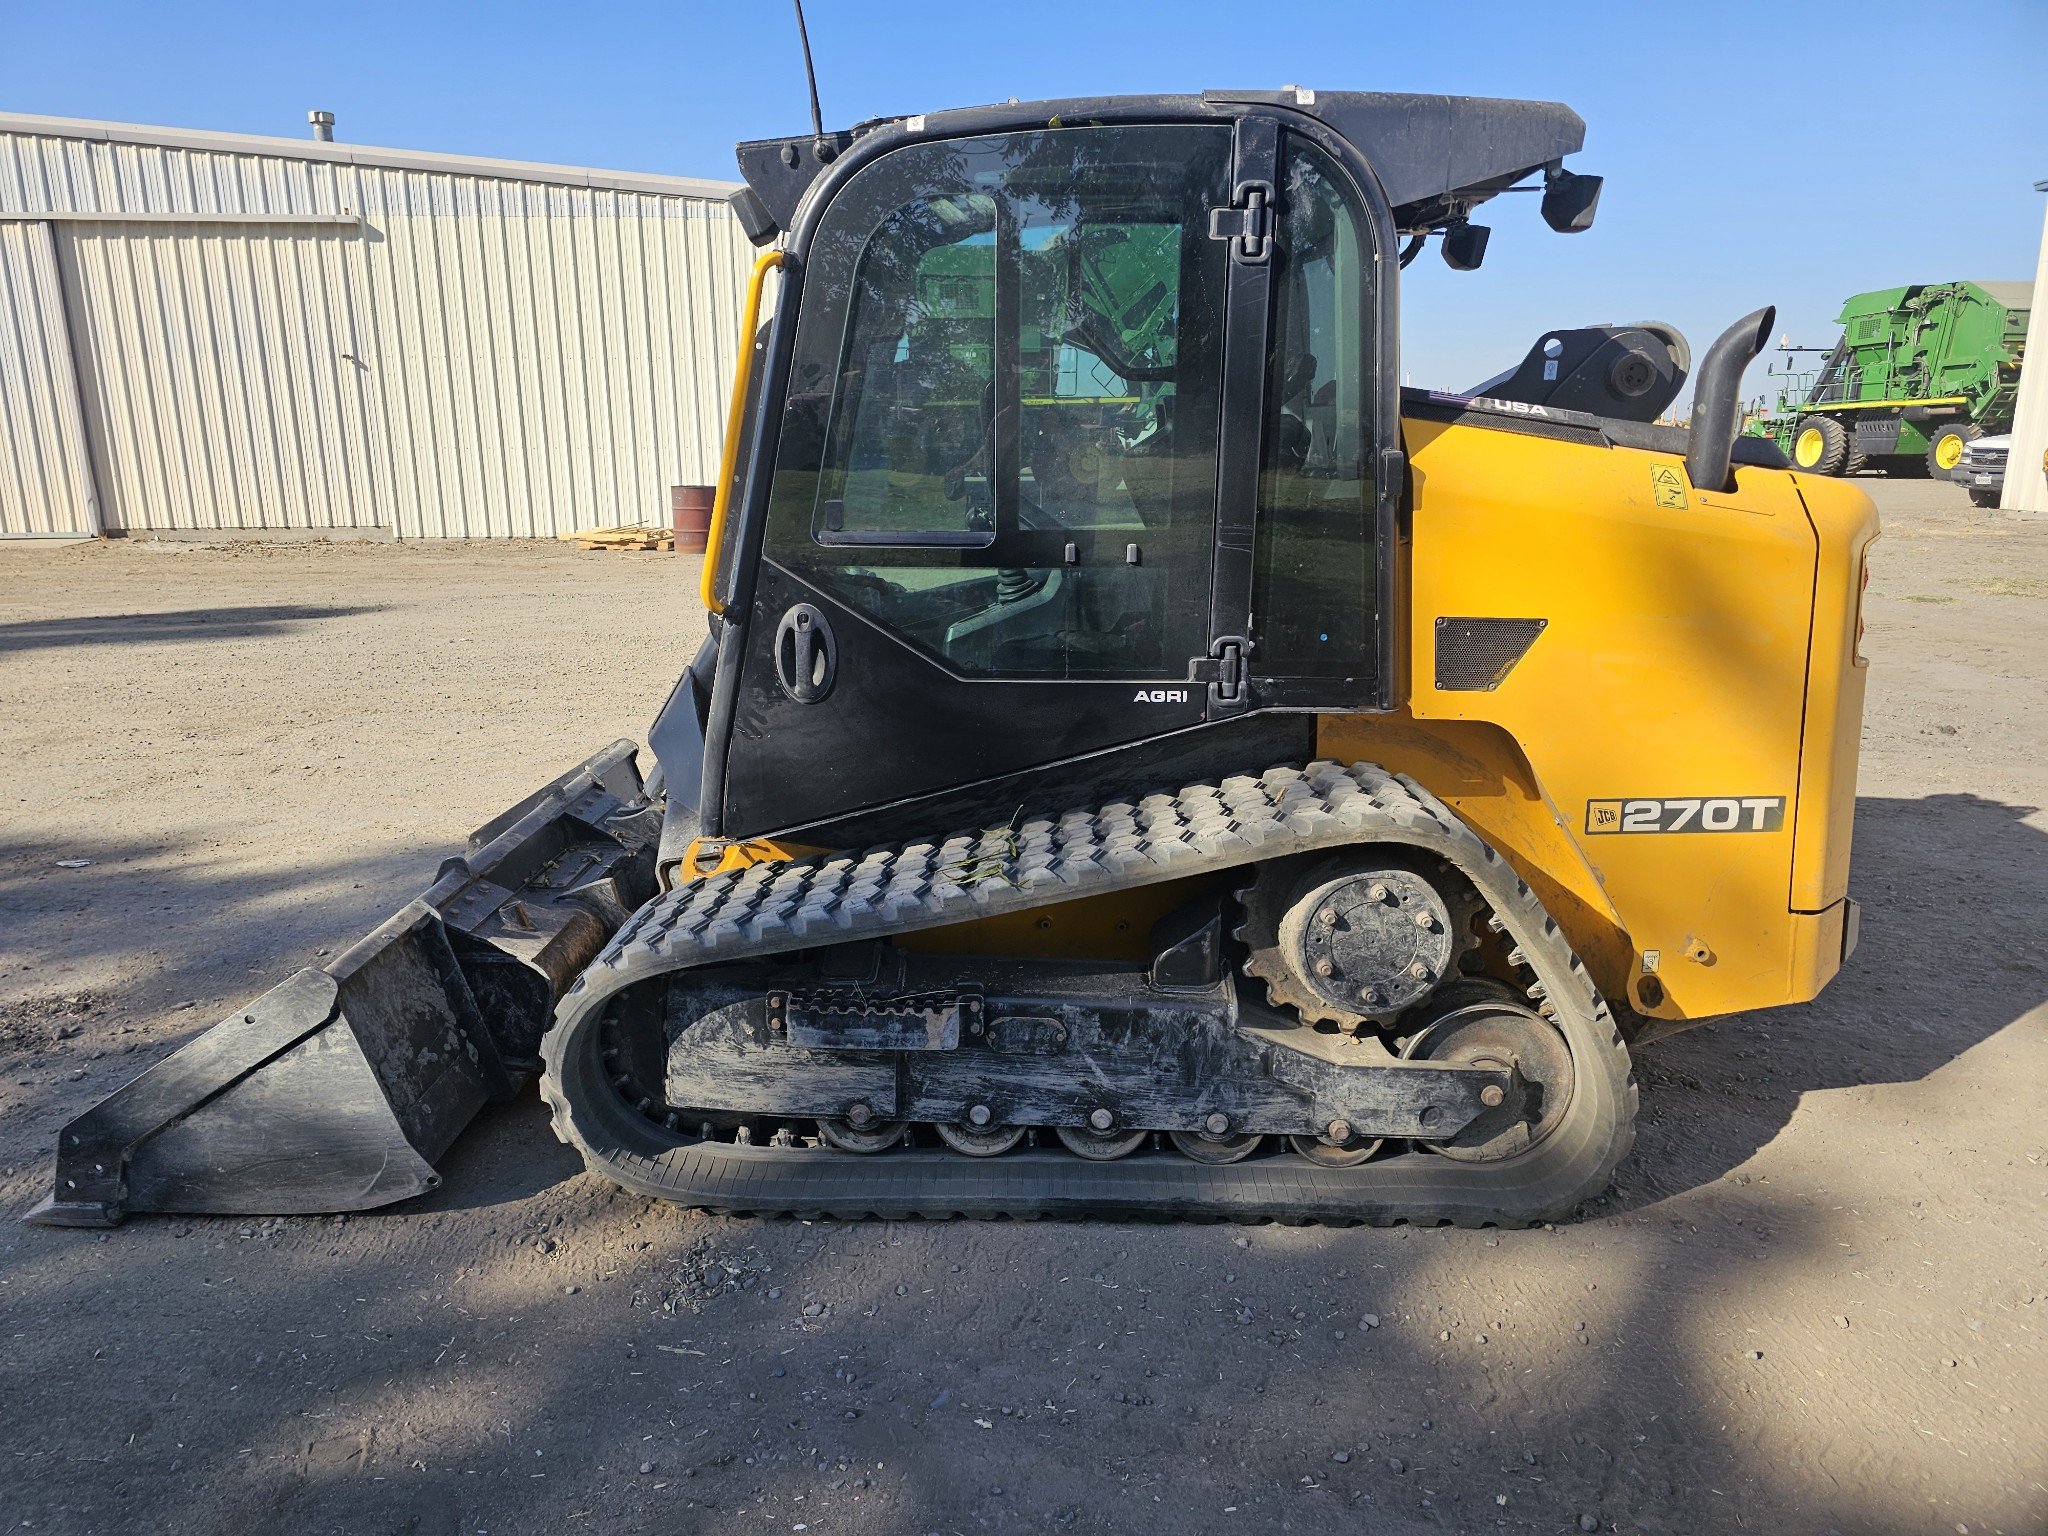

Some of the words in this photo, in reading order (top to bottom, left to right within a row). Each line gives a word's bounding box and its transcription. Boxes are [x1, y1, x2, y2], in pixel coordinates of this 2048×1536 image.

[1494, 399, 1548, 416] USA
[1133, 690, 1188, 702] AGRI
[1597, 808, 1616, 824] JCB
[1623, 799, 1779, 831] 270T
